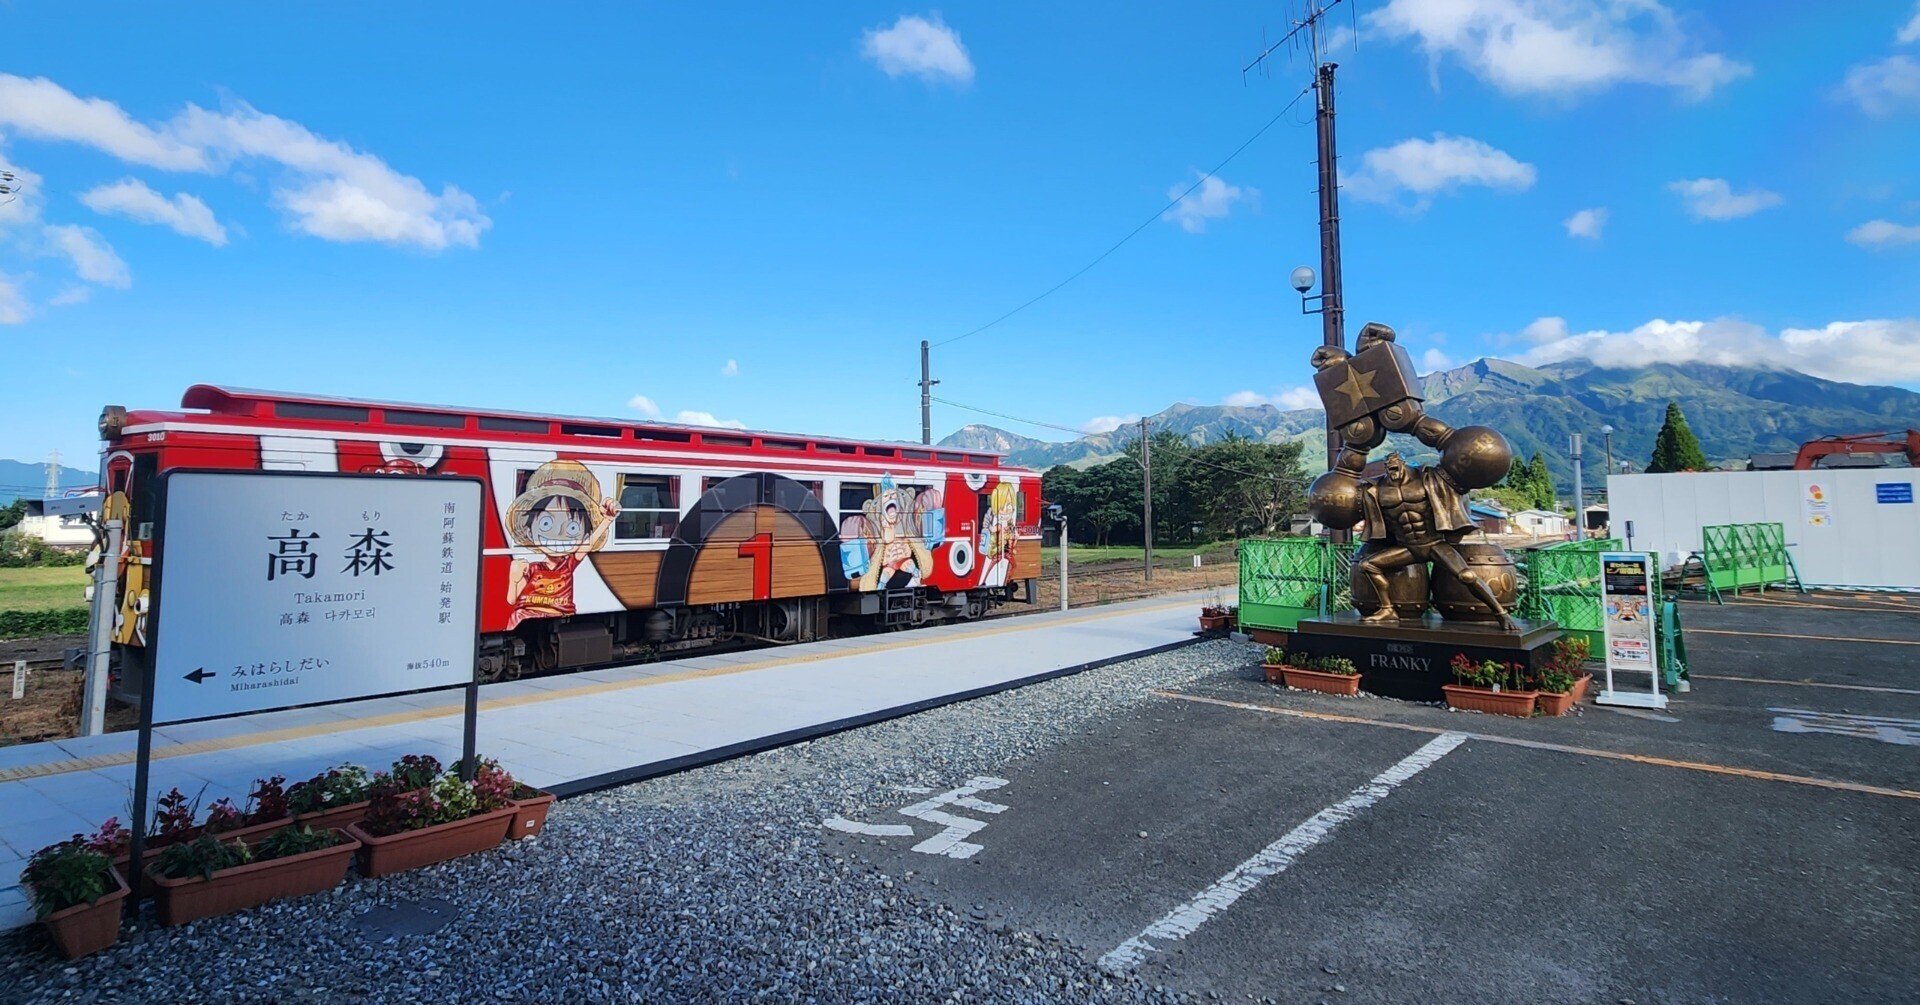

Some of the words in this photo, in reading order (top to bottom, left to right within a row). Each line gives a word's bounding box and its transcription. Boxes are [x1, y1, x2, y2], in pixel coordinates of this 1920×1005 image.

[147, 432, 166, 442] 3010
[281, 511, 309, 521] たか
[362, 511, 381, 521] もり
[440, 502, 456, 574] 南阿蘇鉄道
[267, 527, 396, 581] 高森
[738, 532, 774, 601] 1
[294, 590, 366, 604] Takamori
[438, 581, 452, 625] 始発駅
[525, 595, 569, 606] KUMAMOTO
[280, 611, 311, 626] 高森
[325, 607, 376, 622] 다카모리
[231, 657, 330, 678] みはらしだい
[1370, 653, 1432, 672] FRANKY
[230, 676, 299, 692] Miharashidai
